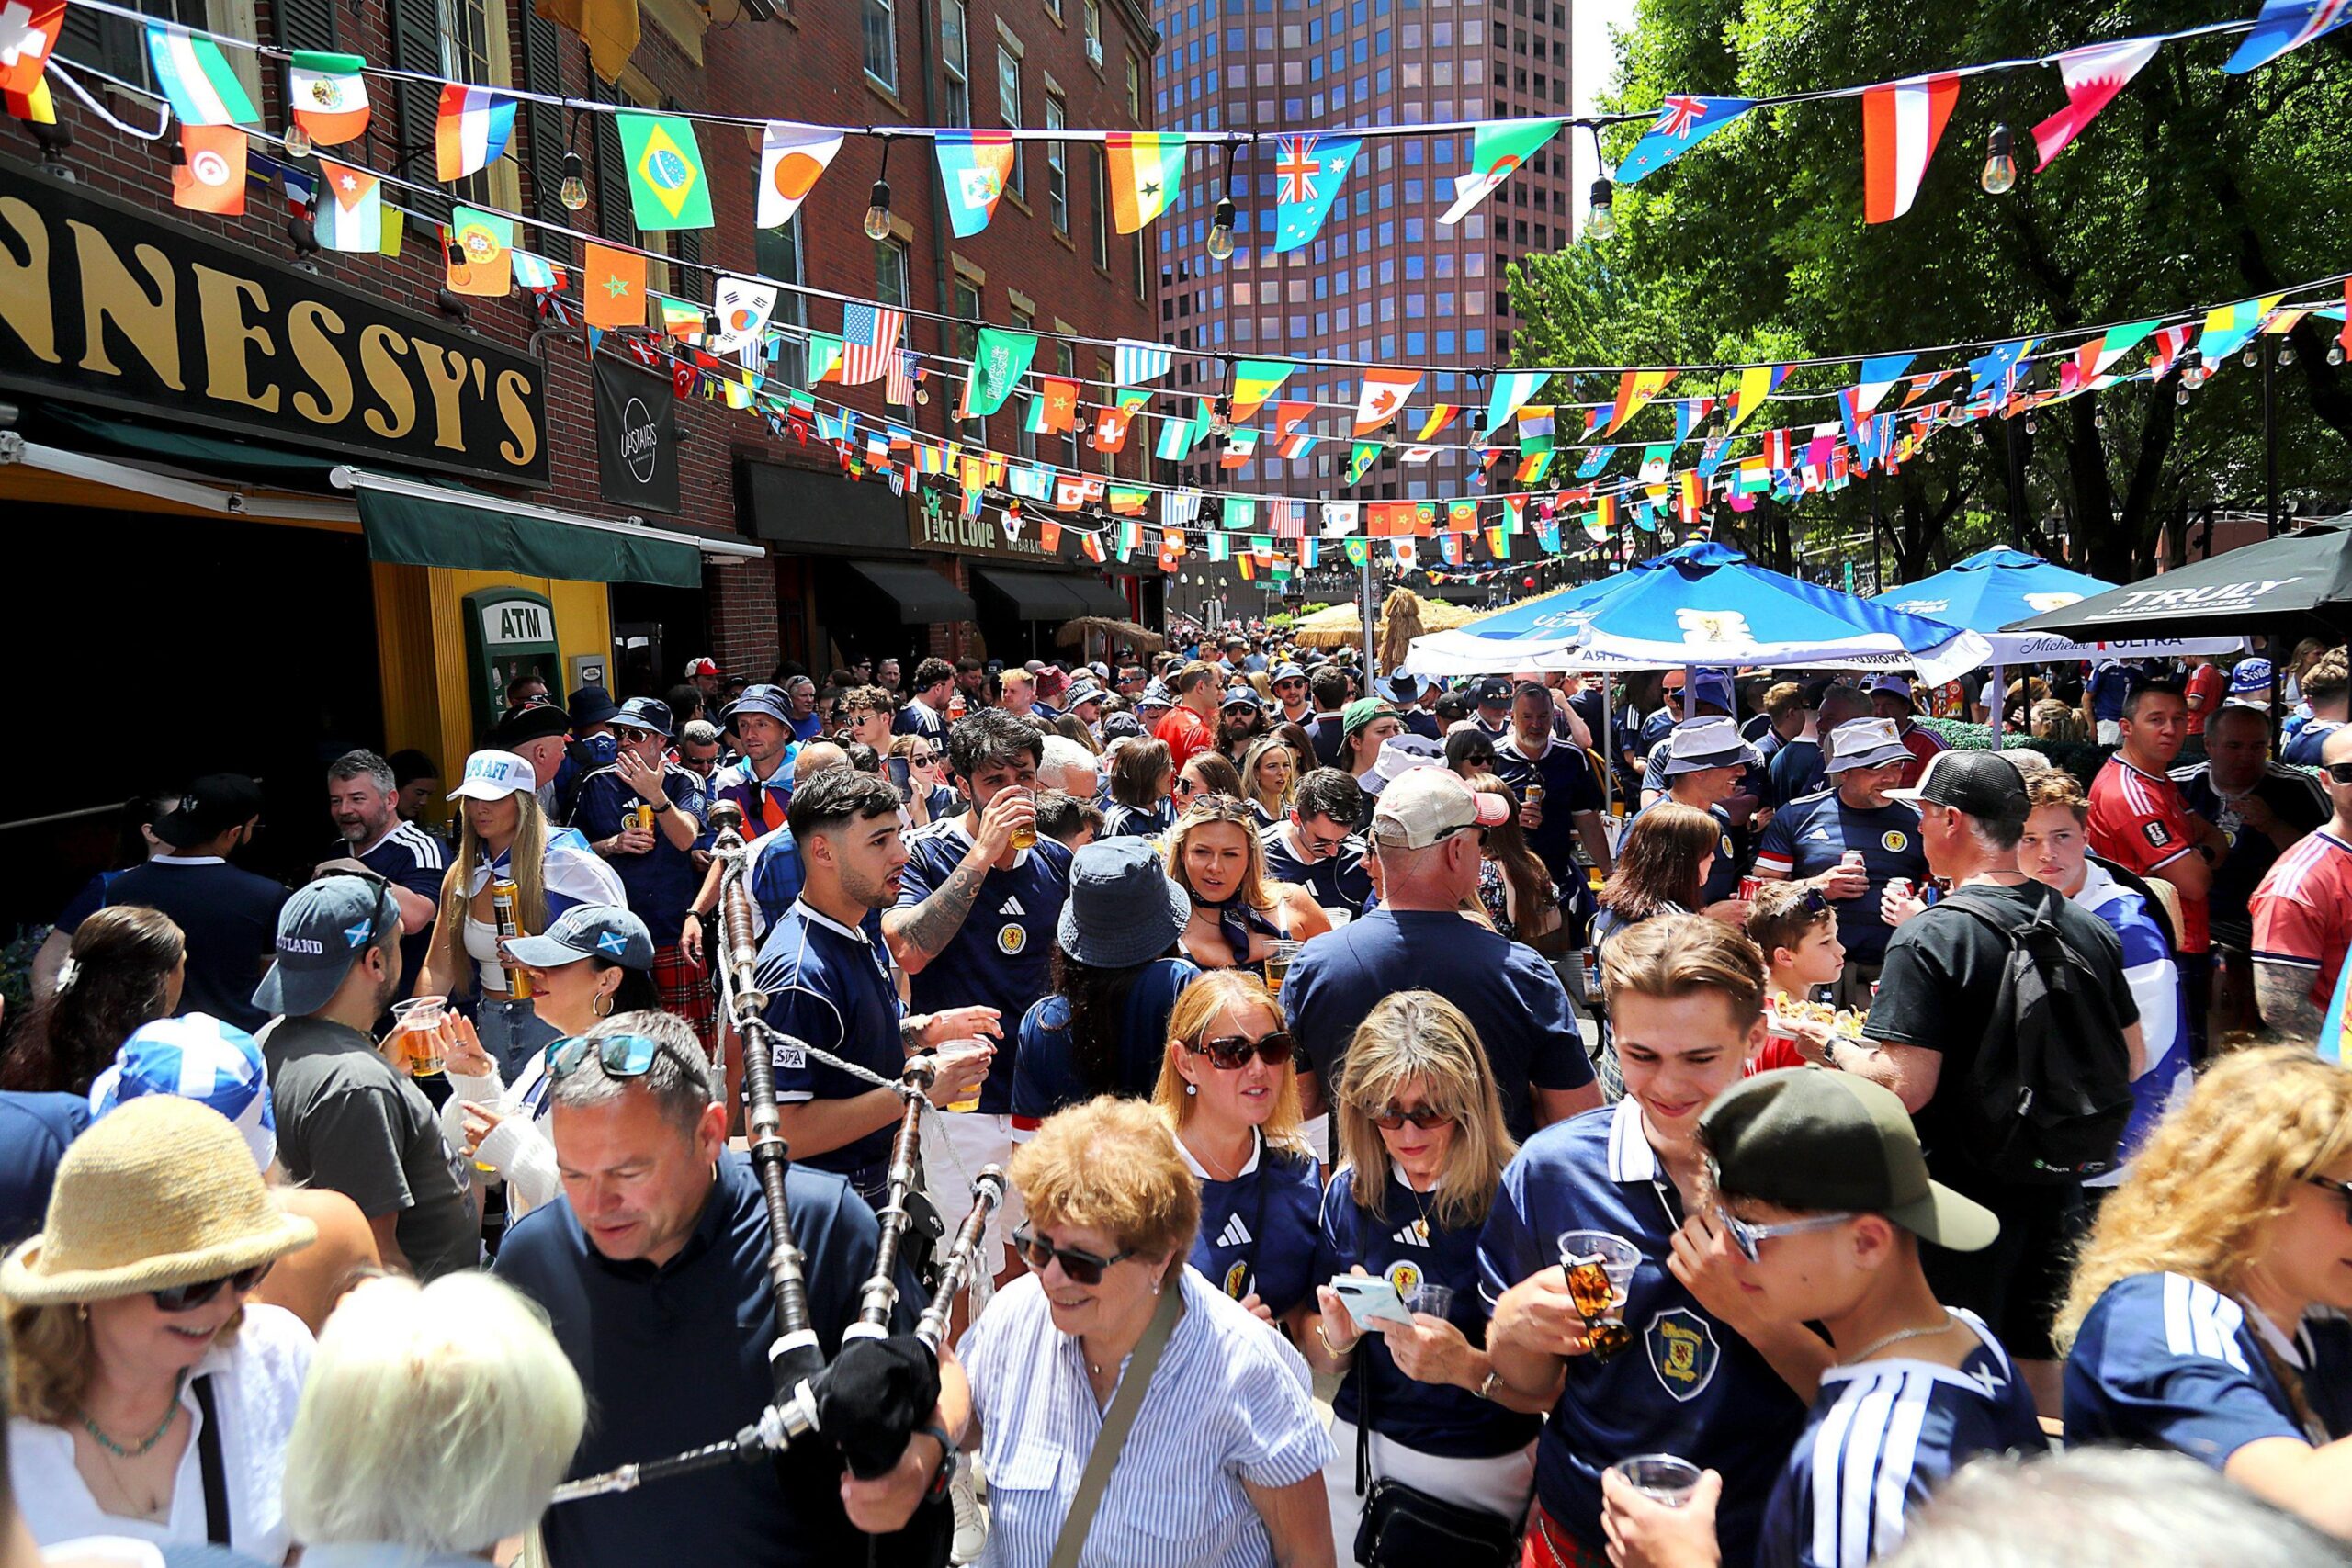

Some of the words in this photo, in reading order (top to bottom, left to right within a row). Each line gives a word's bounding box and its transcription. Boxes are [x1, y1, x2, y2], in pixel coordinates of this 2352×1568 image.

[621, 423, 657, 457] UPSTAIRS
[958, 514, 996, 548] Cove
[1018, 538, 1029, 552] BAR
[1030, 538, 1035, 553] &
[2120, 577, 2304, 608] TRULY
[2106, 604, 2164, 615] HARD
[2166, 597, 2254, 611] SELTZER
[501, 608, 542, 639] ATM
[482, 760, 509, 781] AFF
[775, 1049, 803, 1066] SFA
